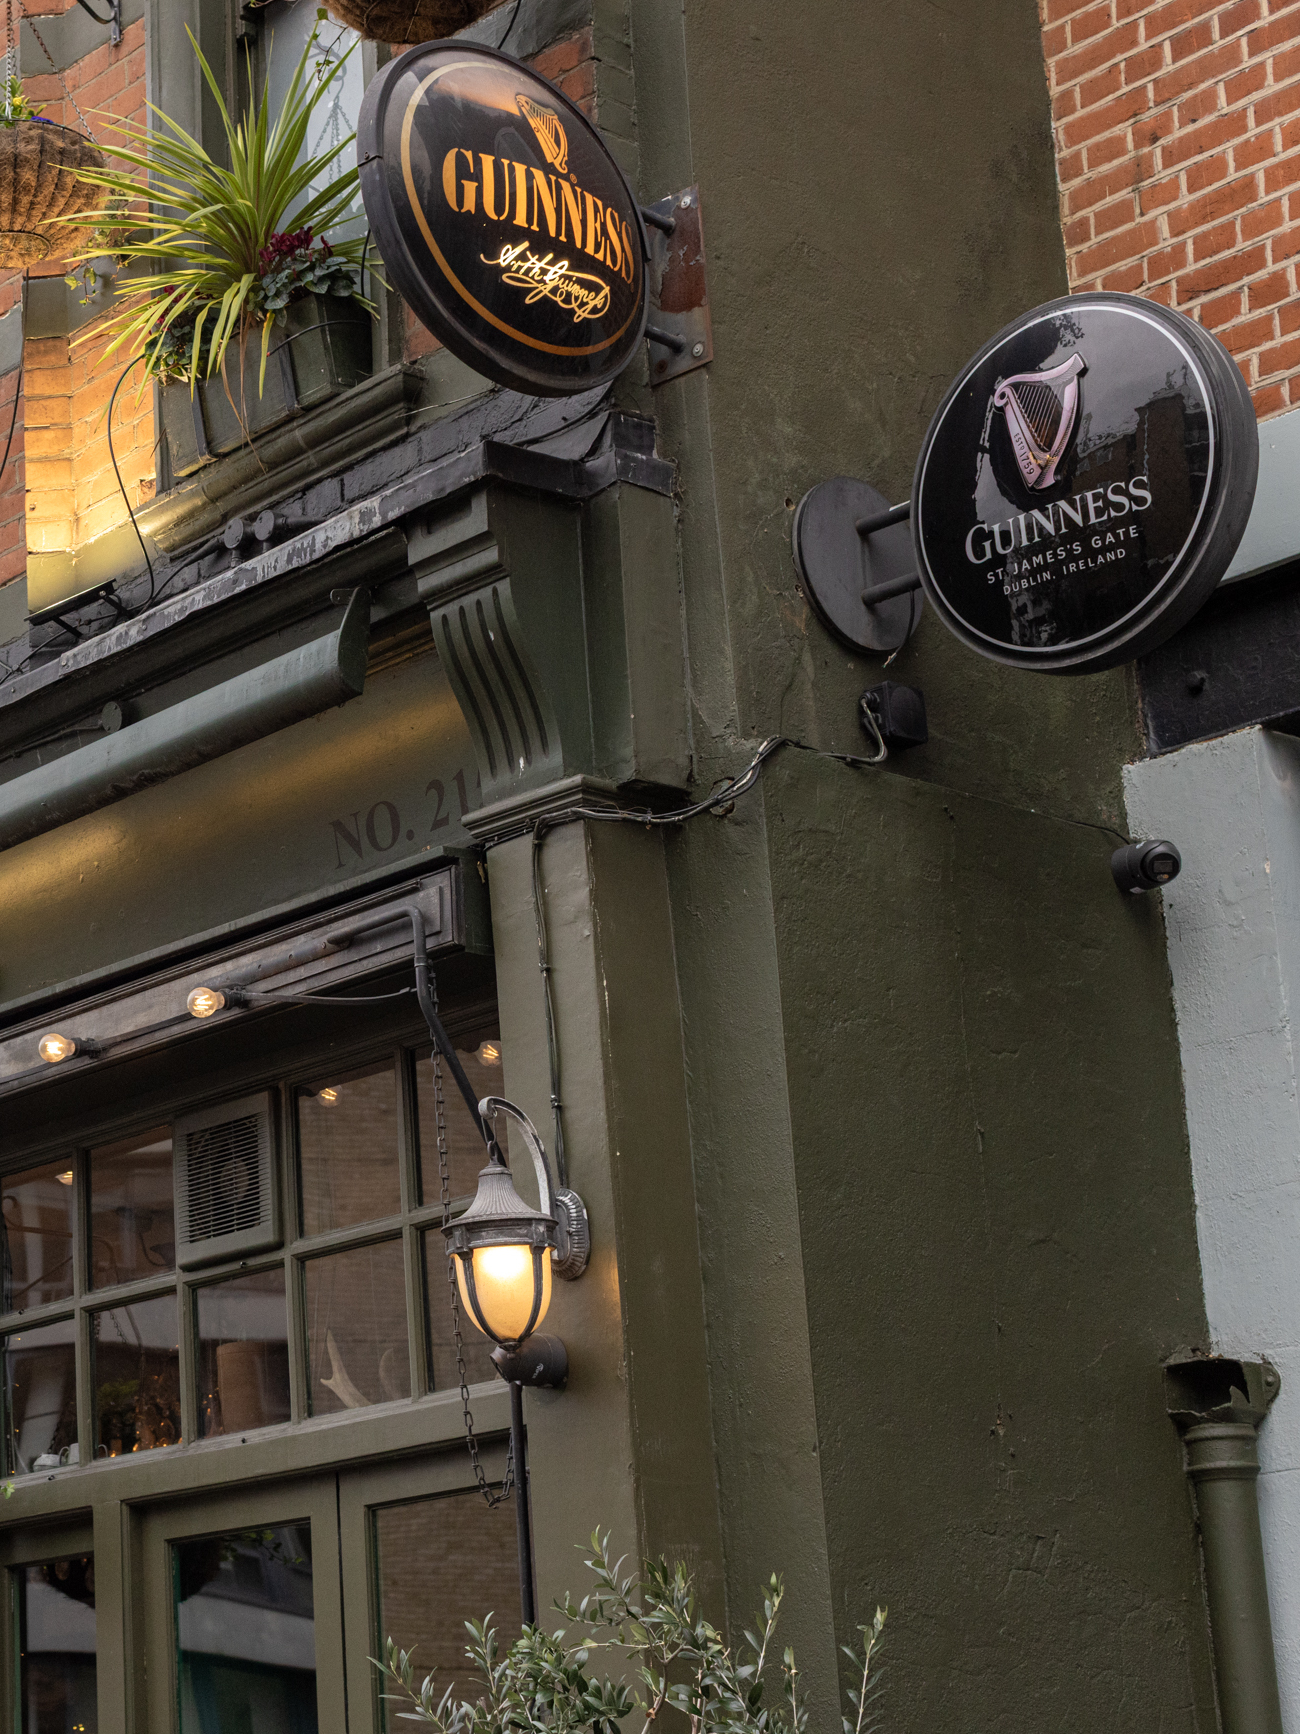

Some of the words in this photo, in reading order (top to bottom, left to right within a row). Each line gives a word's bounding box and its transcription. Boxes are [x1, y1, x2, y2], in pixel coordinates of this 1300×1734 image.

[442, 147, 635, 284] GUINNESS
[1019, 451, 1035, 475] 1759
[965, 475, 1152, 565] GUINNESS
[986, 568, 1005, 584] ST
[1013, 541, 1082, 575] JAMES'S
[1091, 525, 1139, 549] GATE
[1062, 548, 1126, 575] IRELAND
[329, 800, 415, 869] NO.
